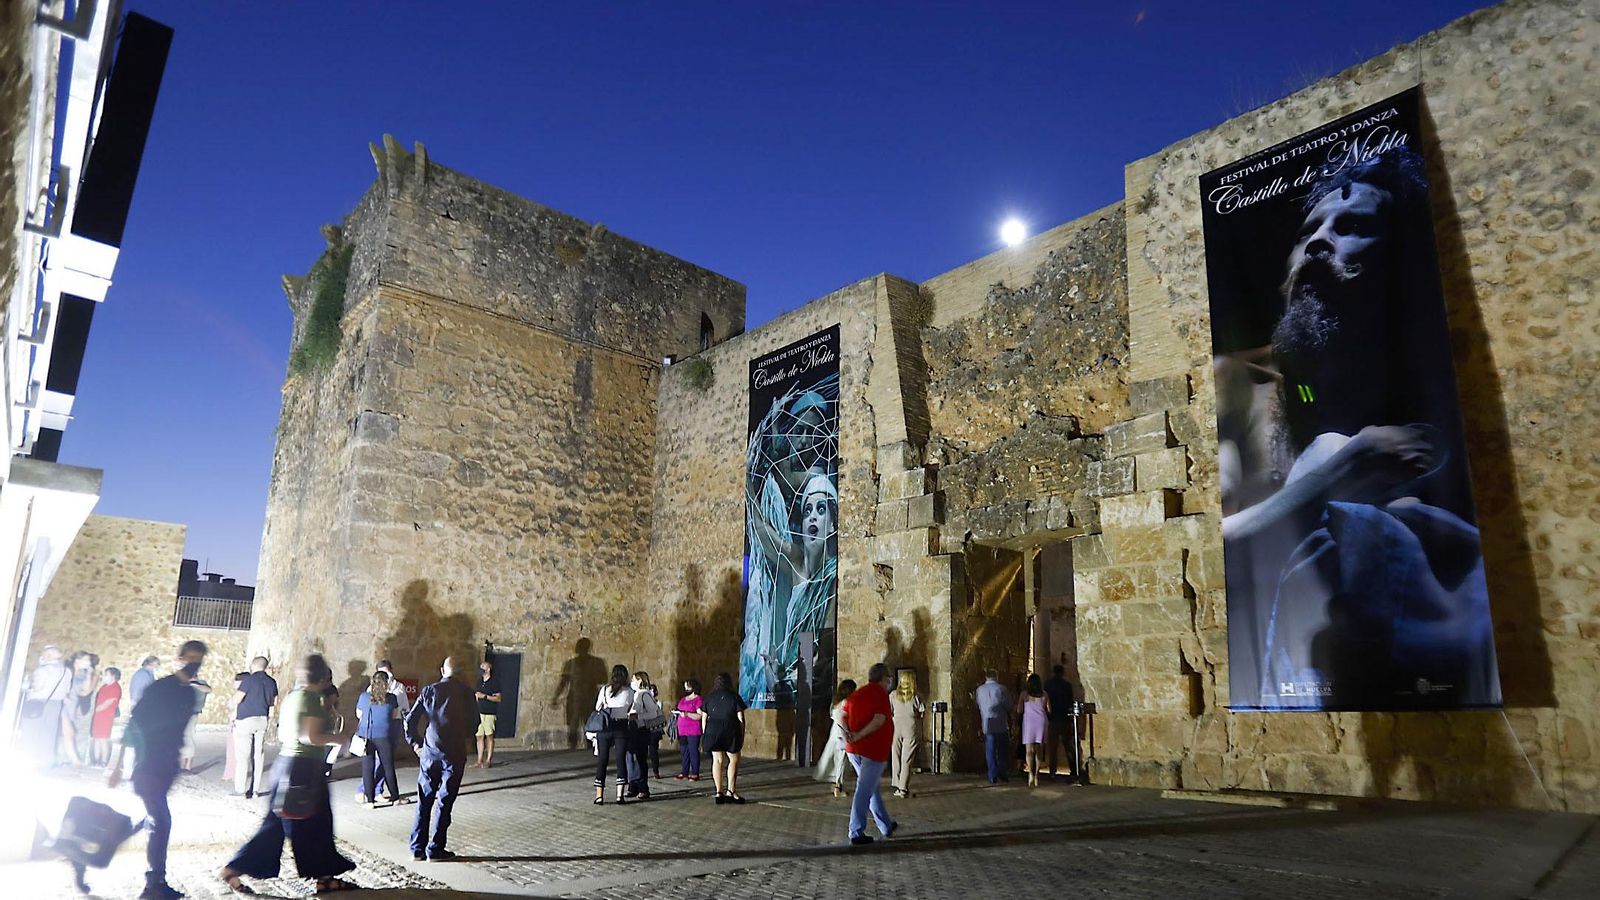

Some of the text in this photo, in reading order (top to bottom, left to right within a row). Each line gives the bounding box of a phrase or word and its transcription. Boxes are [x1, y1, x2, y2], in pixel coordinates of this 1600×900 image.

[1208, 125, 1408, 215] Castillo de Niebla
[1220, 107, 1399, 185] FESTIVAL DE TEATRO Y DANZA
[752, 344, 835, 390] Castillo de Niebla
[758, 355, 779, 368] FESTIVAL
[787, 343, 808, 357] TEATRO
